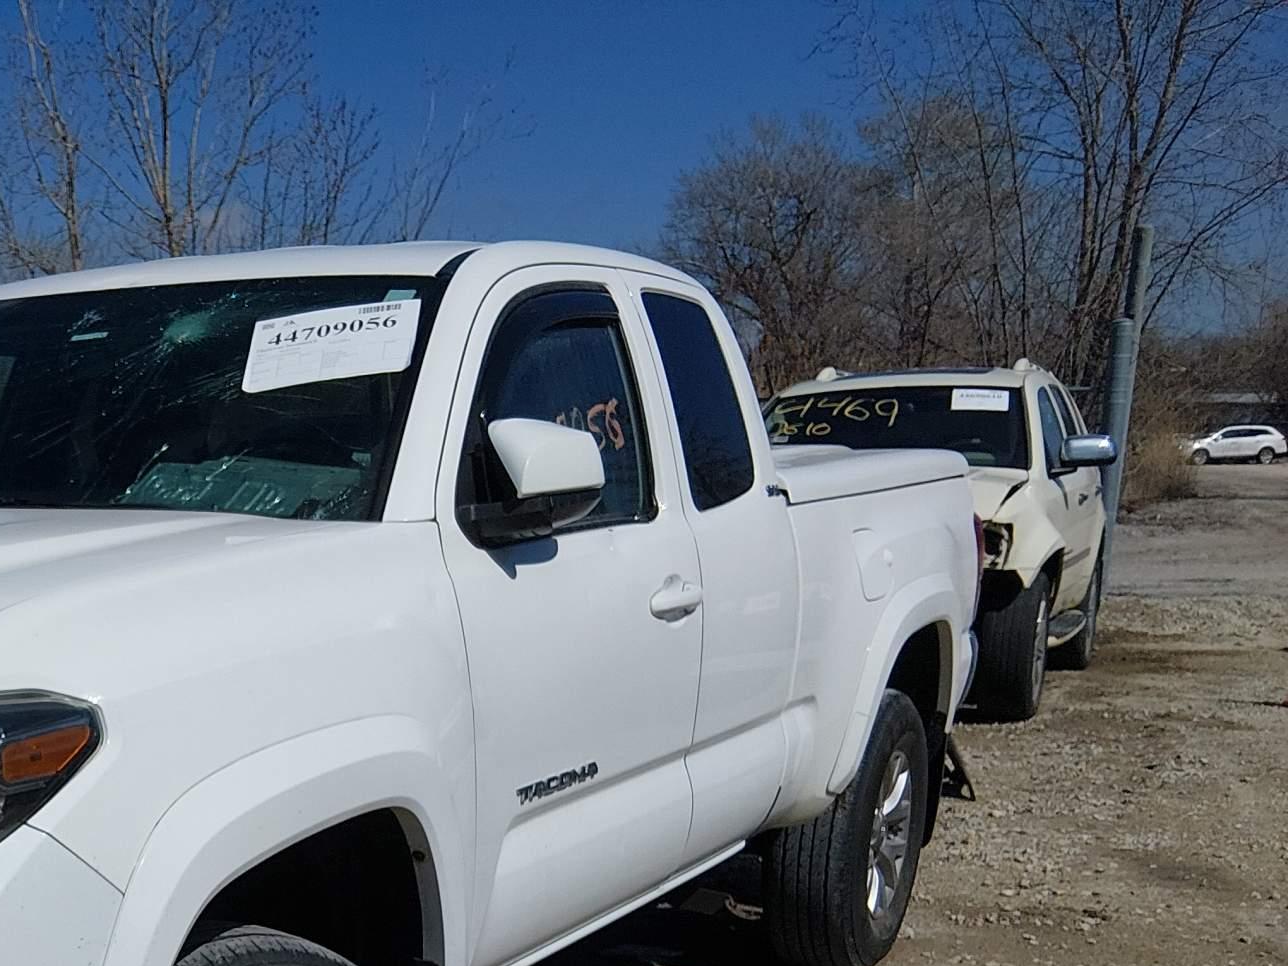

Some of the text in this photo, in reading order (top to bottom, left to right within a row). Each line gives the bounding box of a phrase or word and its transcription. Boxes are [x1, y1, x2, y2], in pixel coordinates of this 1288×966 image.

[267, 315, 398, 346] 44709056
[774, 396, 899, 428] 4469
[516, 761, 599, 806] TACOMA
